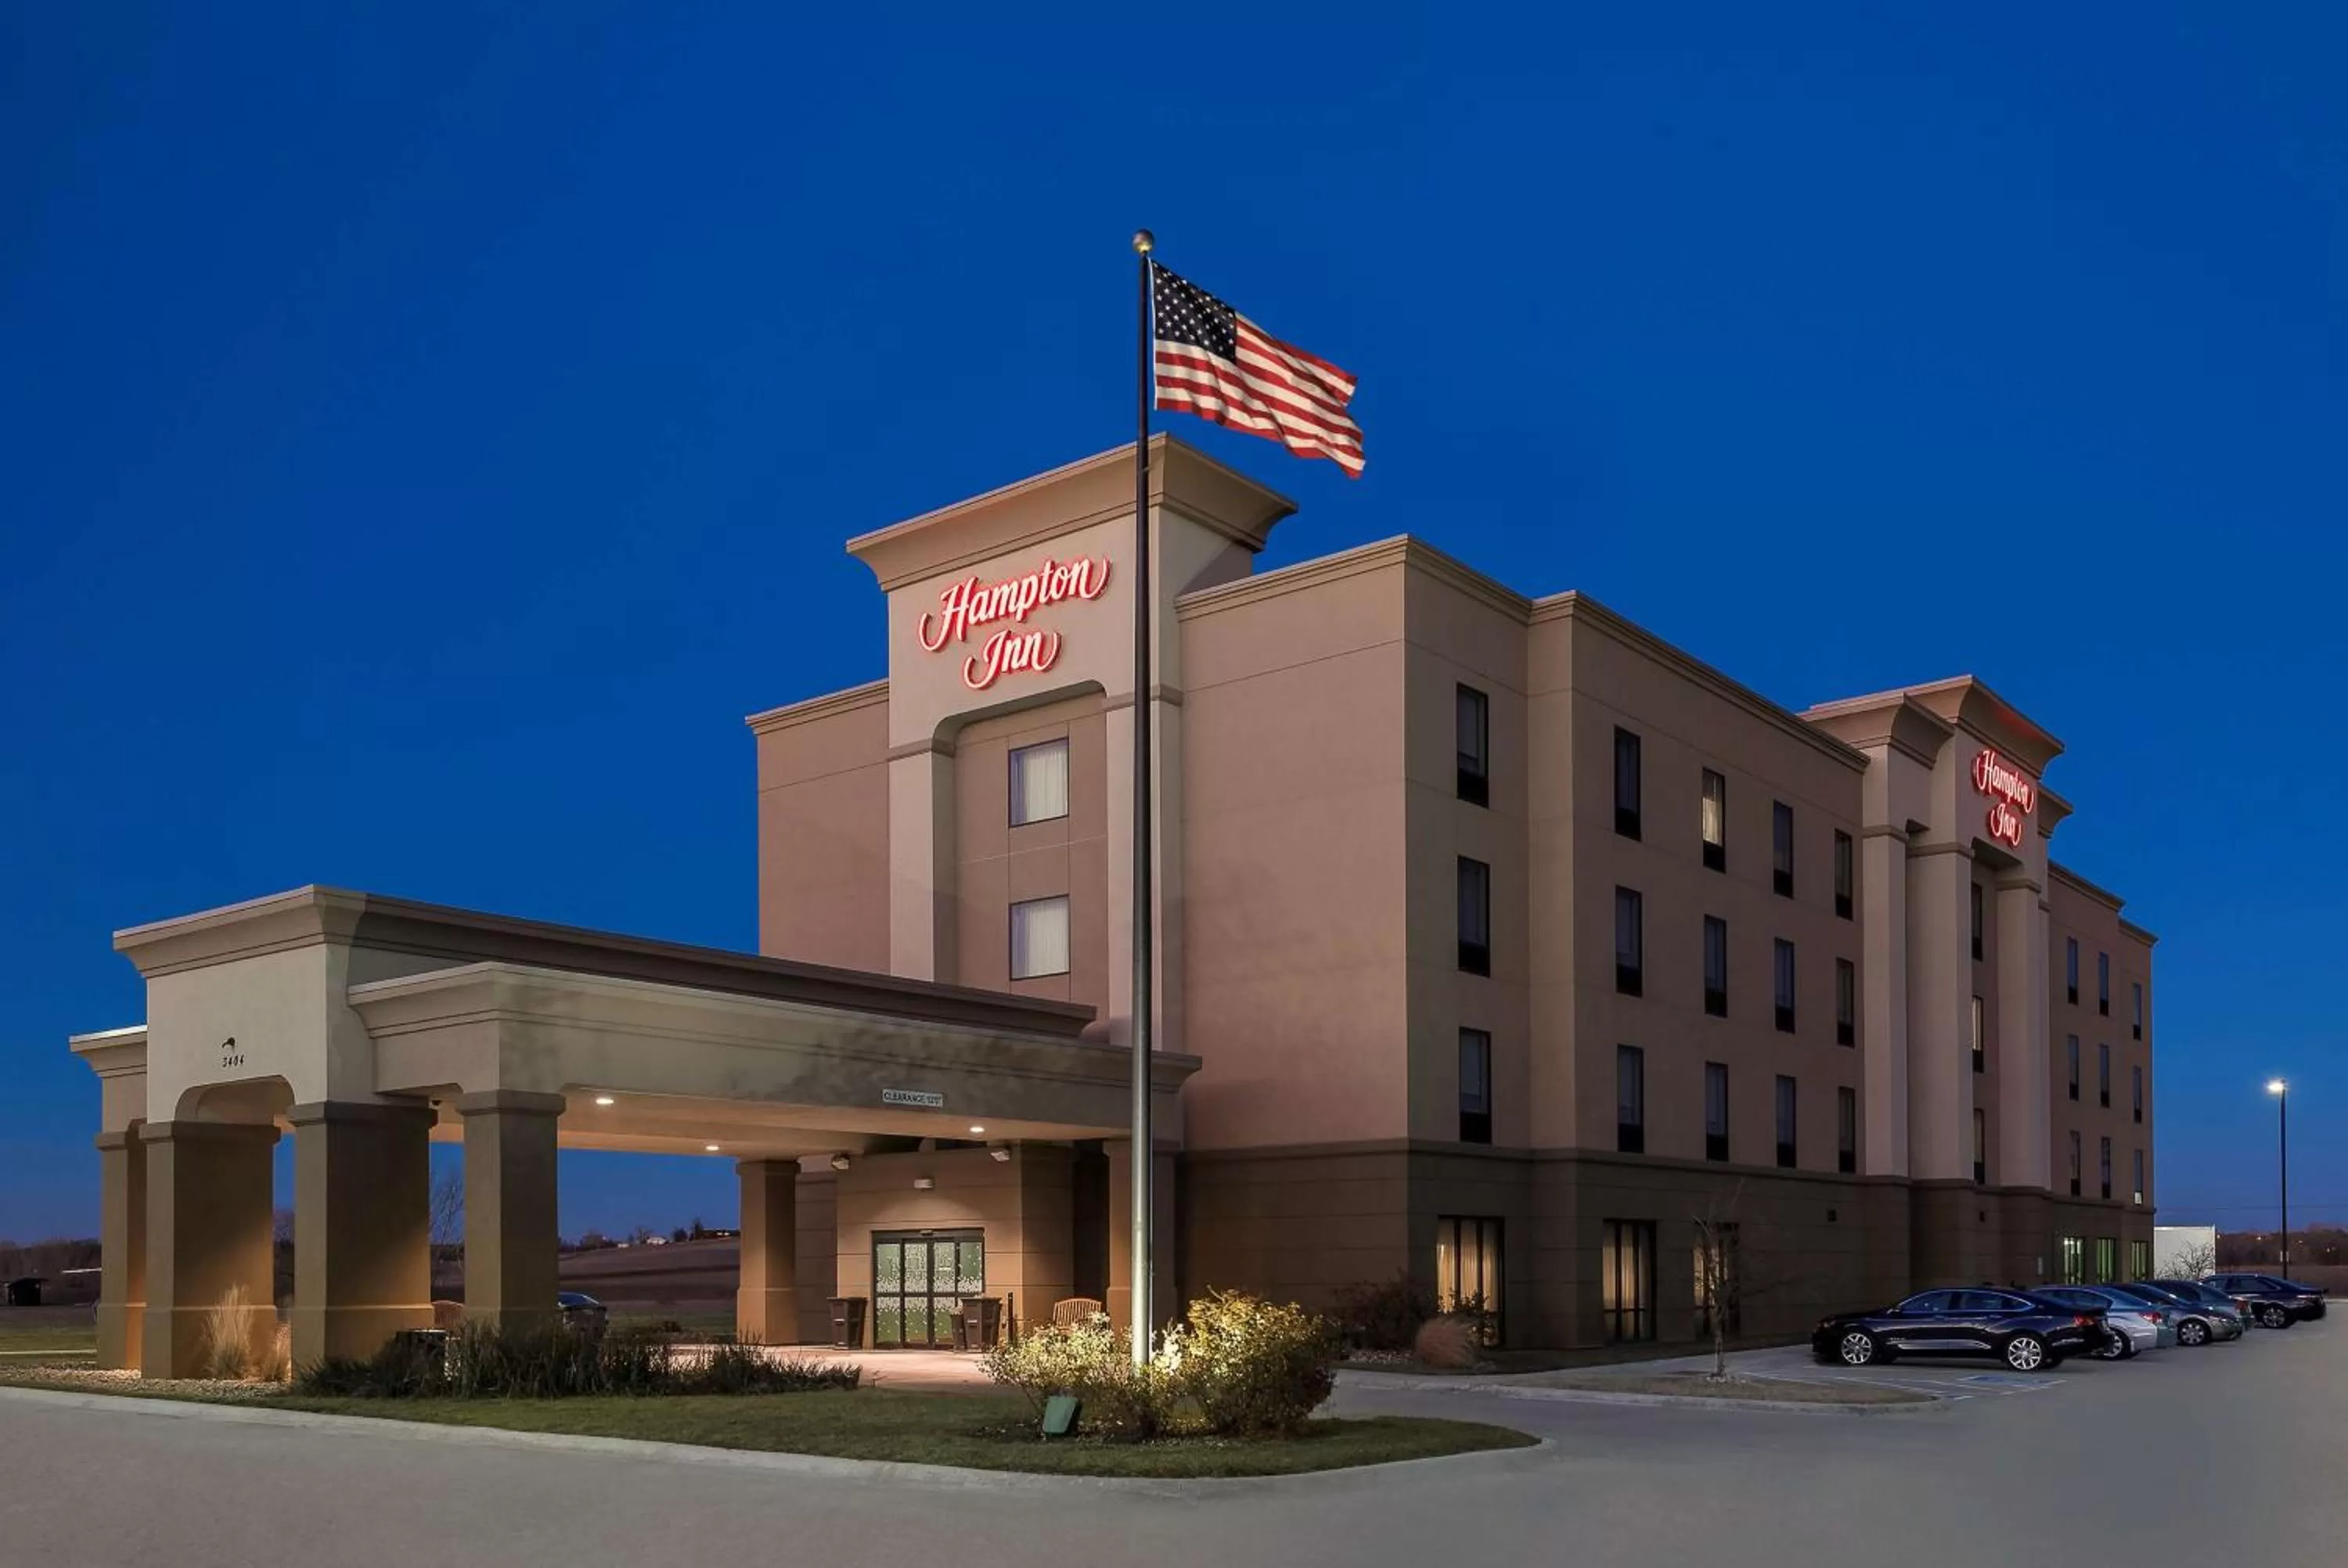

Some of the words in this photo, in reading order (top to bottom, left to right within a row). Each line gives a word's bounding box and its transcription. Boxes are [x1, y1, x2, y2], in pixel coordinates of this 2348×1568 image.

[919, 556, 1111, 653] Hampton
[963, 630, 1061, 689] Inn
[1975, 750, 2034, 813] Hampton
[1990, 803, 2022, 846] Inn
[884, 1091, 926, 1104] CLEARANCE
